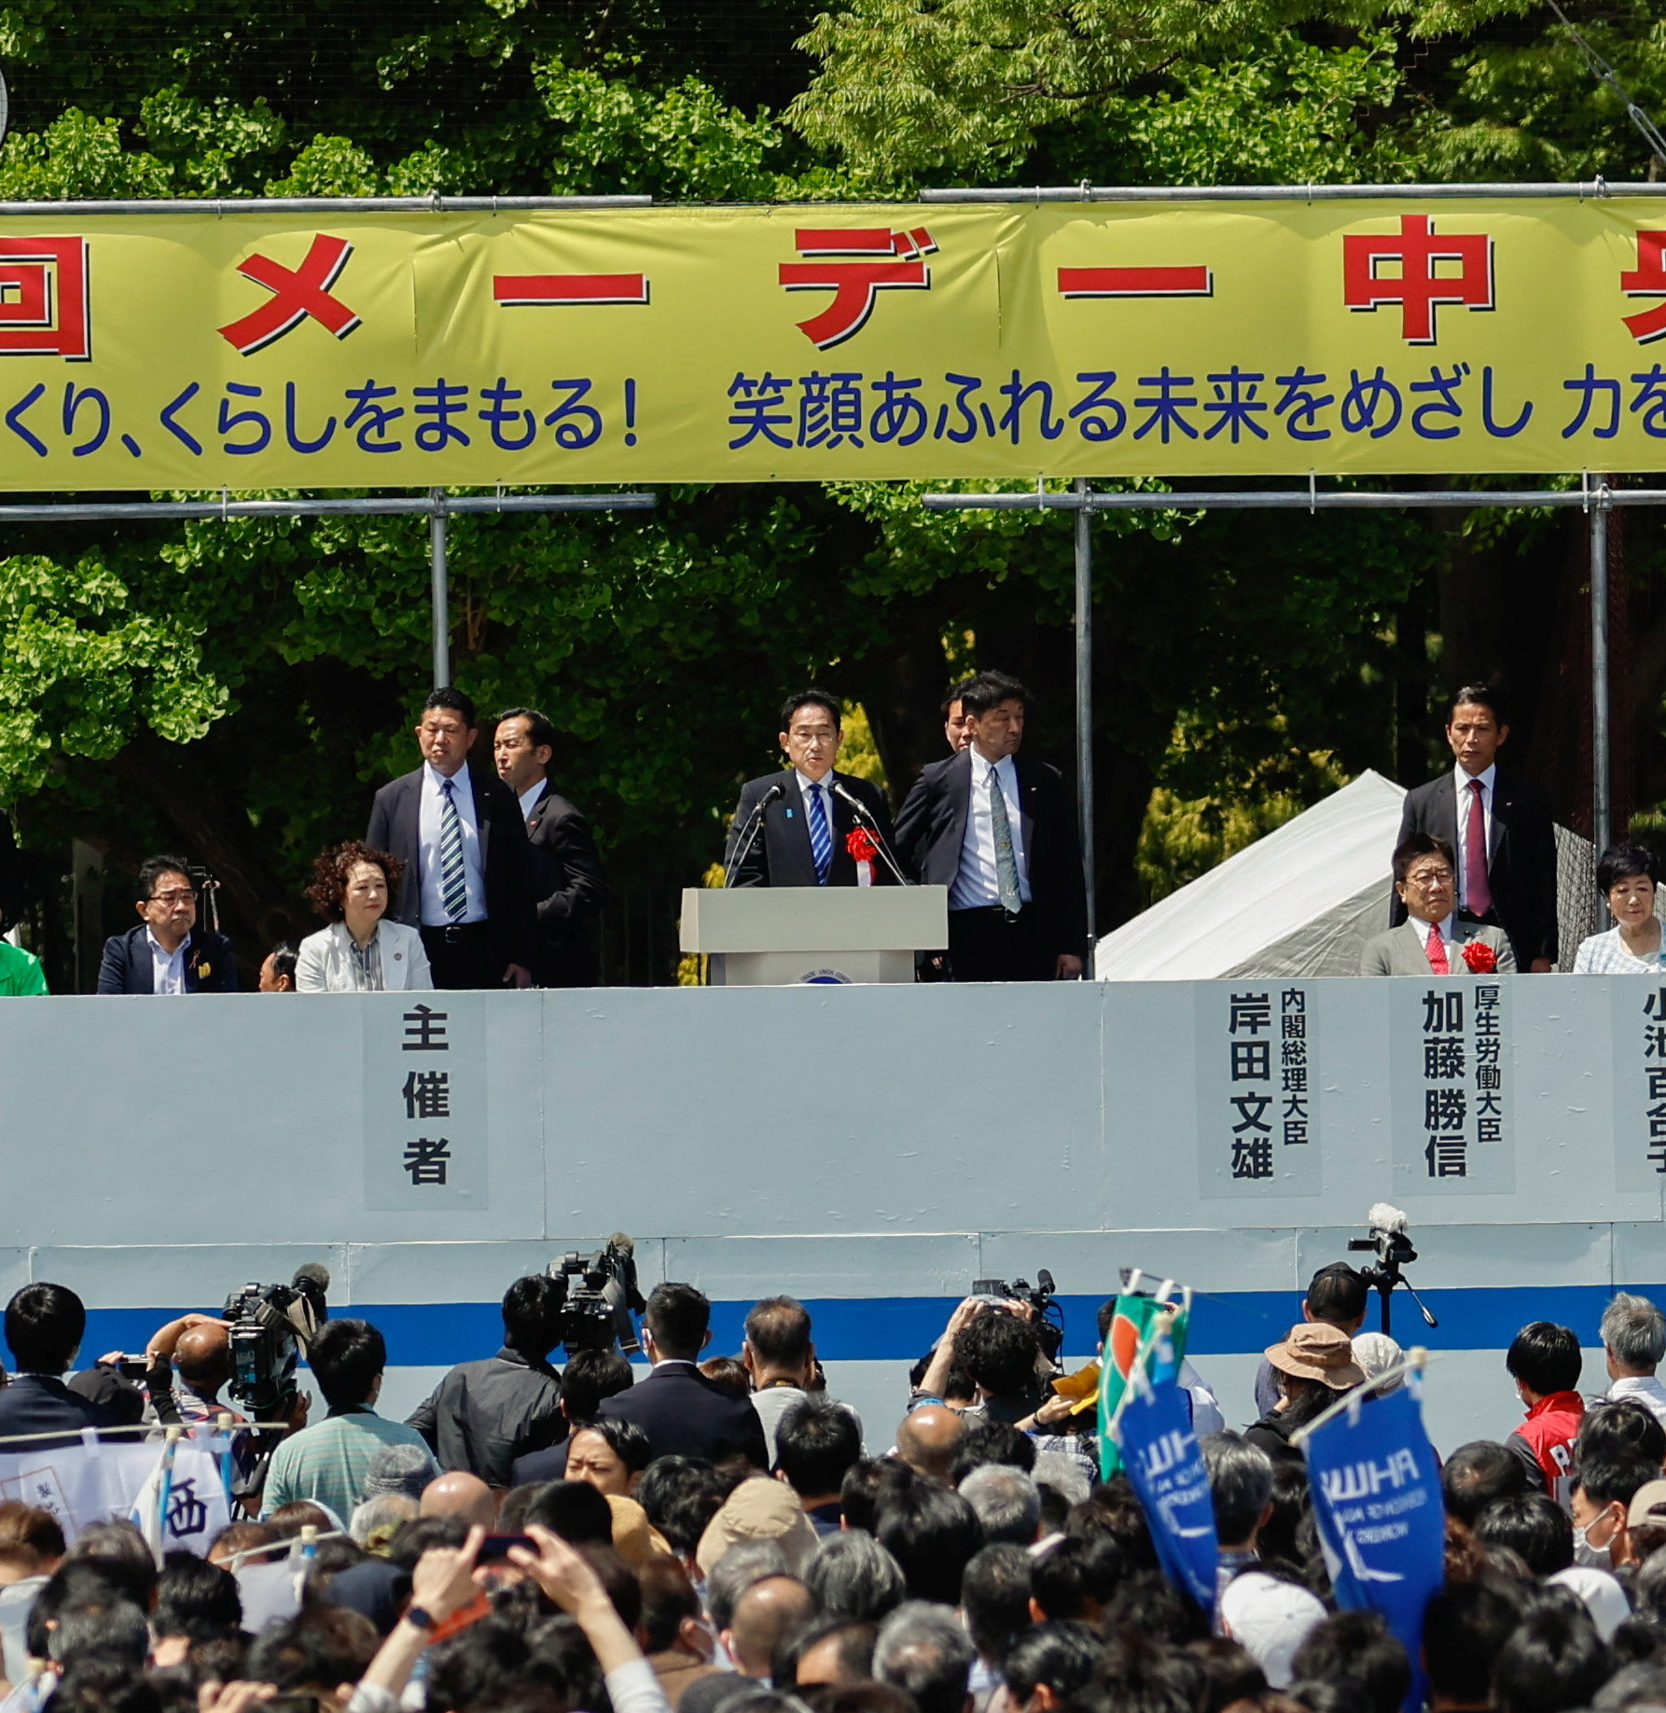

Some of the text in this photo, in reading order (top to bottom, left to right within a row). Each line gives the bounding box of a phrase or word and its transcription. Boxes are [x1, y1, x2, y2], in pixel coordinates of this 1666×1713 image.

[402, 1003, 451, 1185] 主催者
[1228, 992, 1274, 1179] 岸田文雄
[1281, 987, 1309, 1145] 内閣総理大臣
[1422, 990, 1467, 1178] 加藤勝信
[1474, 984, 1502, 1143] 厚生労働大臣
